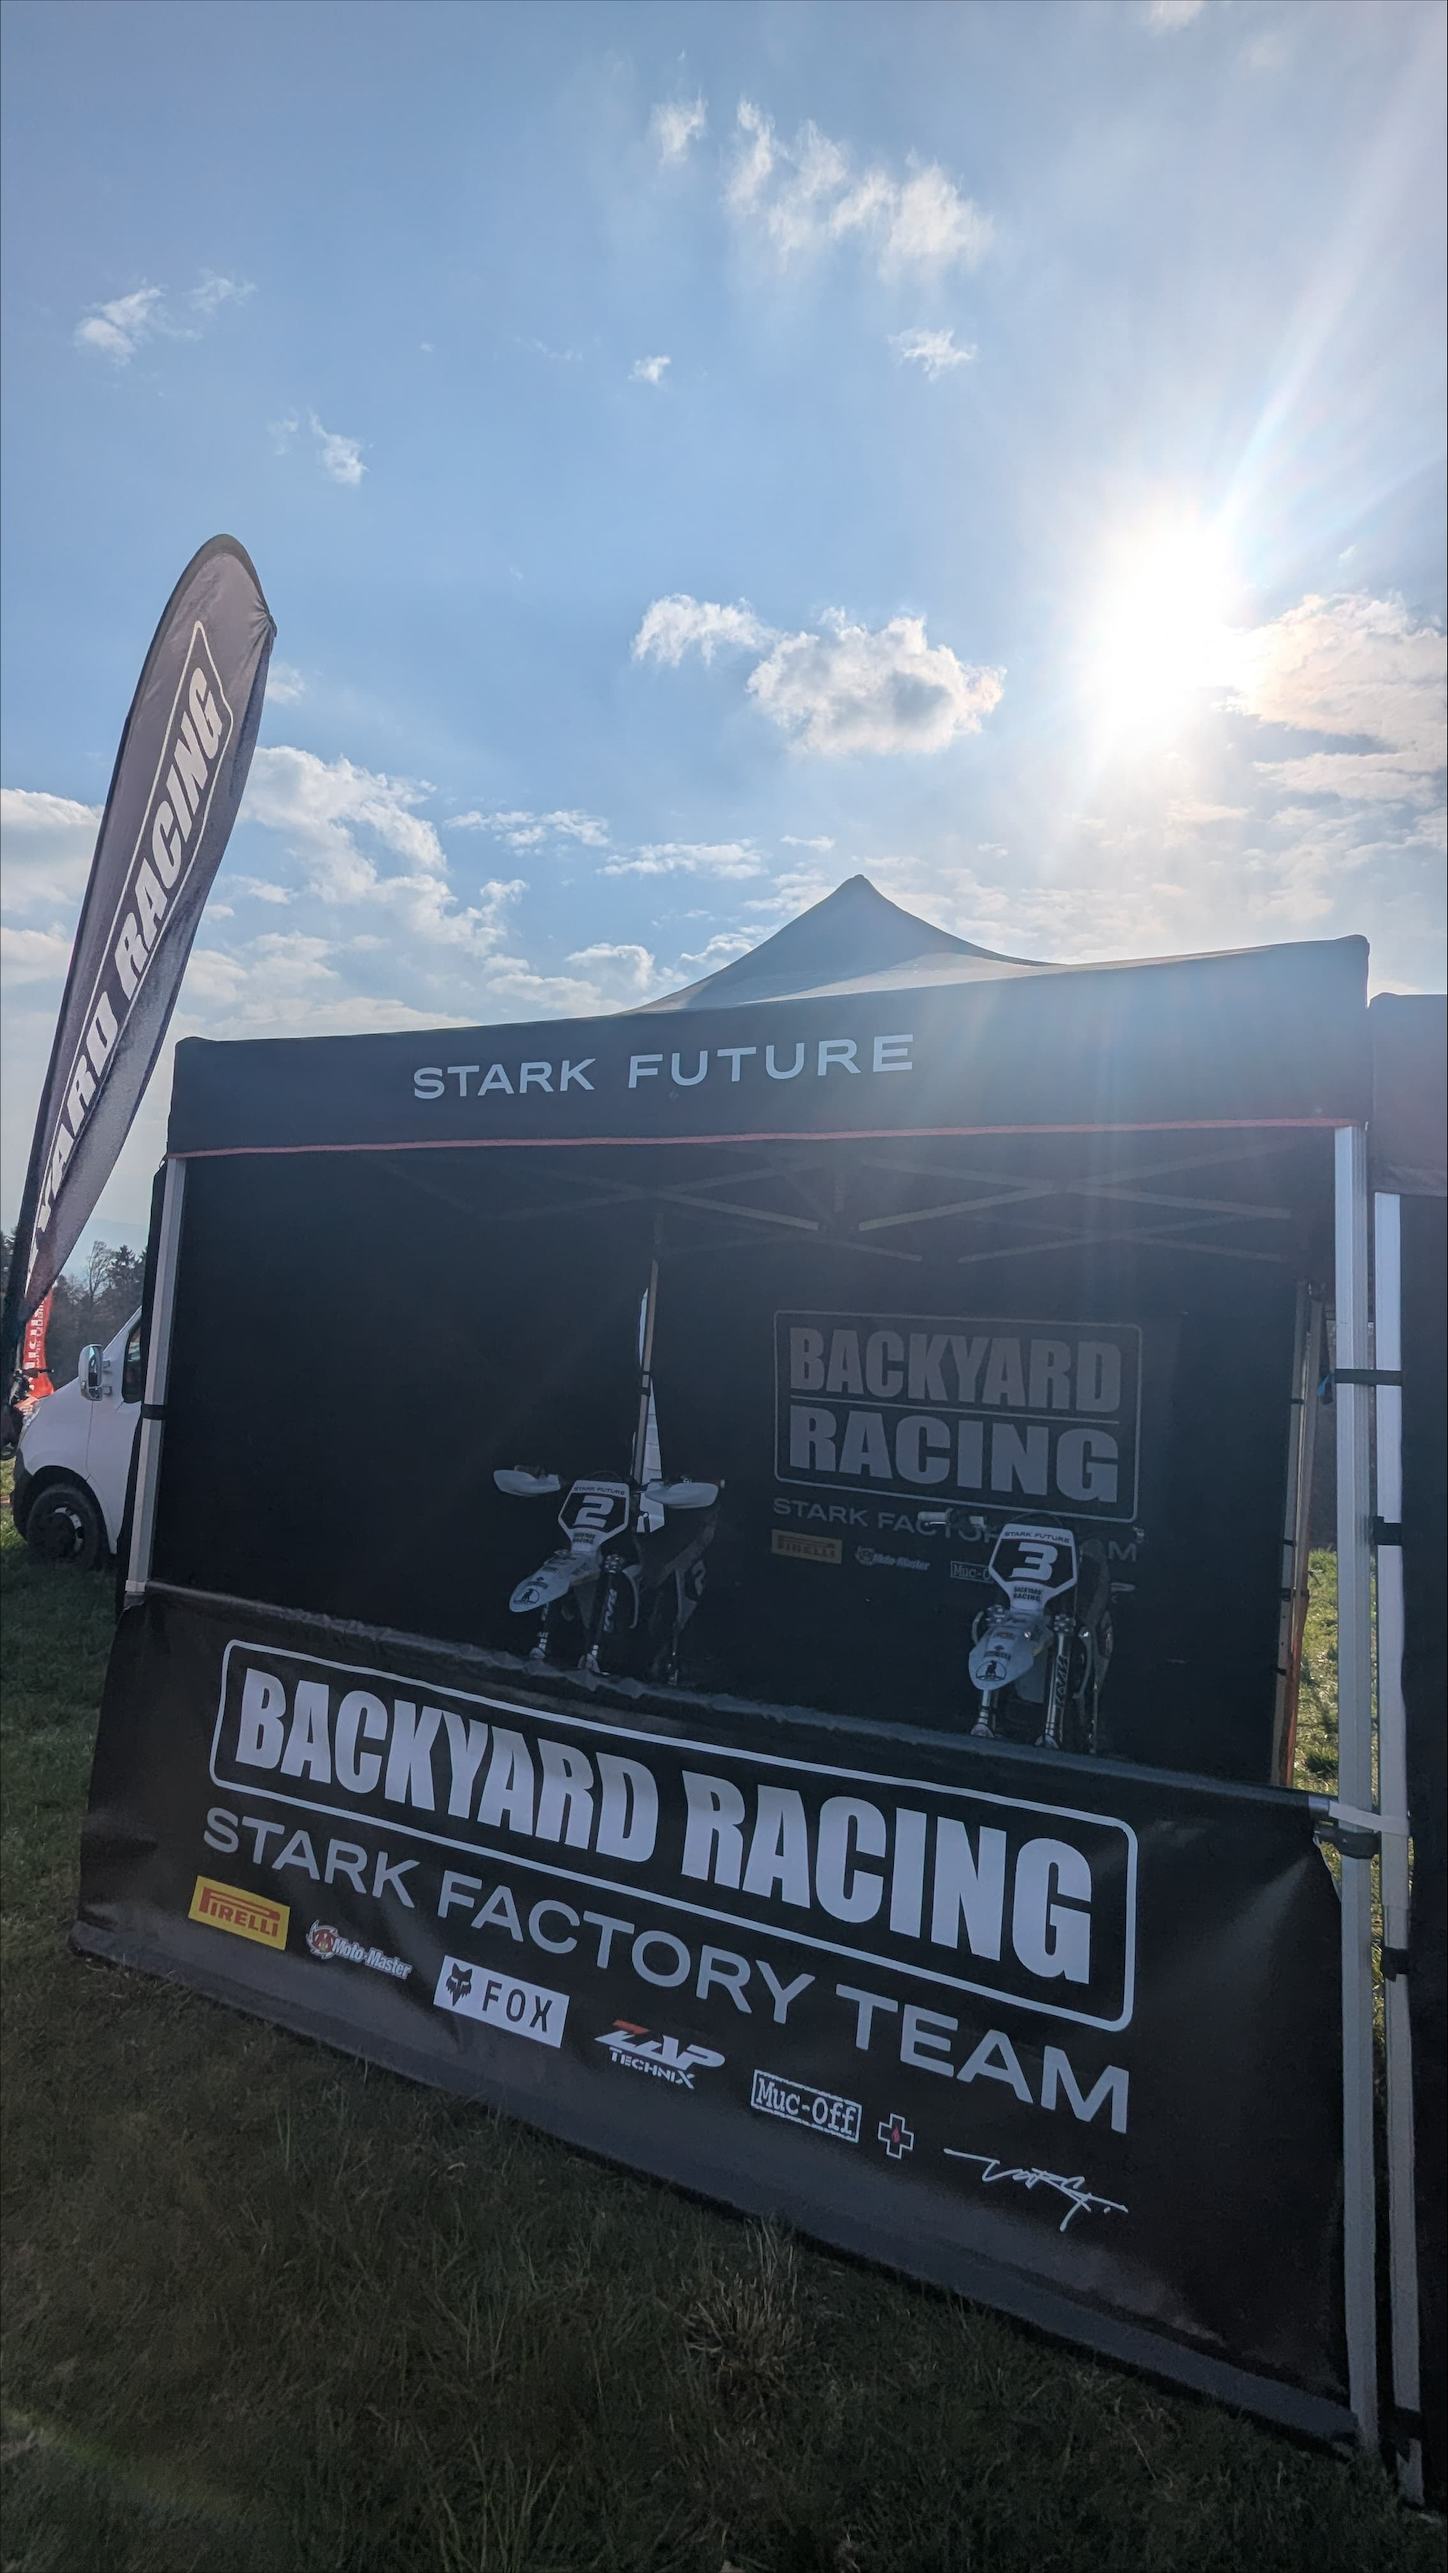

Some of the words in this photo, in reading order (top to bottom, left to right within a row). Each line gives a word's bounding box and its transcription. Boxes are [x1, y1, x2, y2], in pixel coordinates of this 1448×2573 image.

[115, 668, 222, 1000] RACING
[413, 1058, 596, 1099] STARK
[628, 1034, 914, 1088] FUTURE
[789, 1327, 1121, 1414] BACKYARD
[789, 1405, 1119, 1504] RACING
[572, 1495, 615, 1528] 2
[773, 1498, 869, 1528] STARK
[1034, 1532, 1071, 1544] FUTURE
[952, 1563, 992, 1581] Muc-O
[1008, 1541, 1058, 1581] 3
[235, 1667, 660, 1863] BACKYARD
[681, 1770, 1092, 1985] RACING
[198, 1886, 281, 1938] PIRELLI
[203, 1807, 420, 1909] STARK
[437, 1870, 815, 2024] FACTORY
[836, 1983, 1130, 2134] TEAM
[332, 1936, 413, 1980] Moto-Master
[481, 1979, 553, 2033] FOX
[594, 2018, 726, 2071] ZAP
[756, 2077, 857, 2135] Muc-Off
